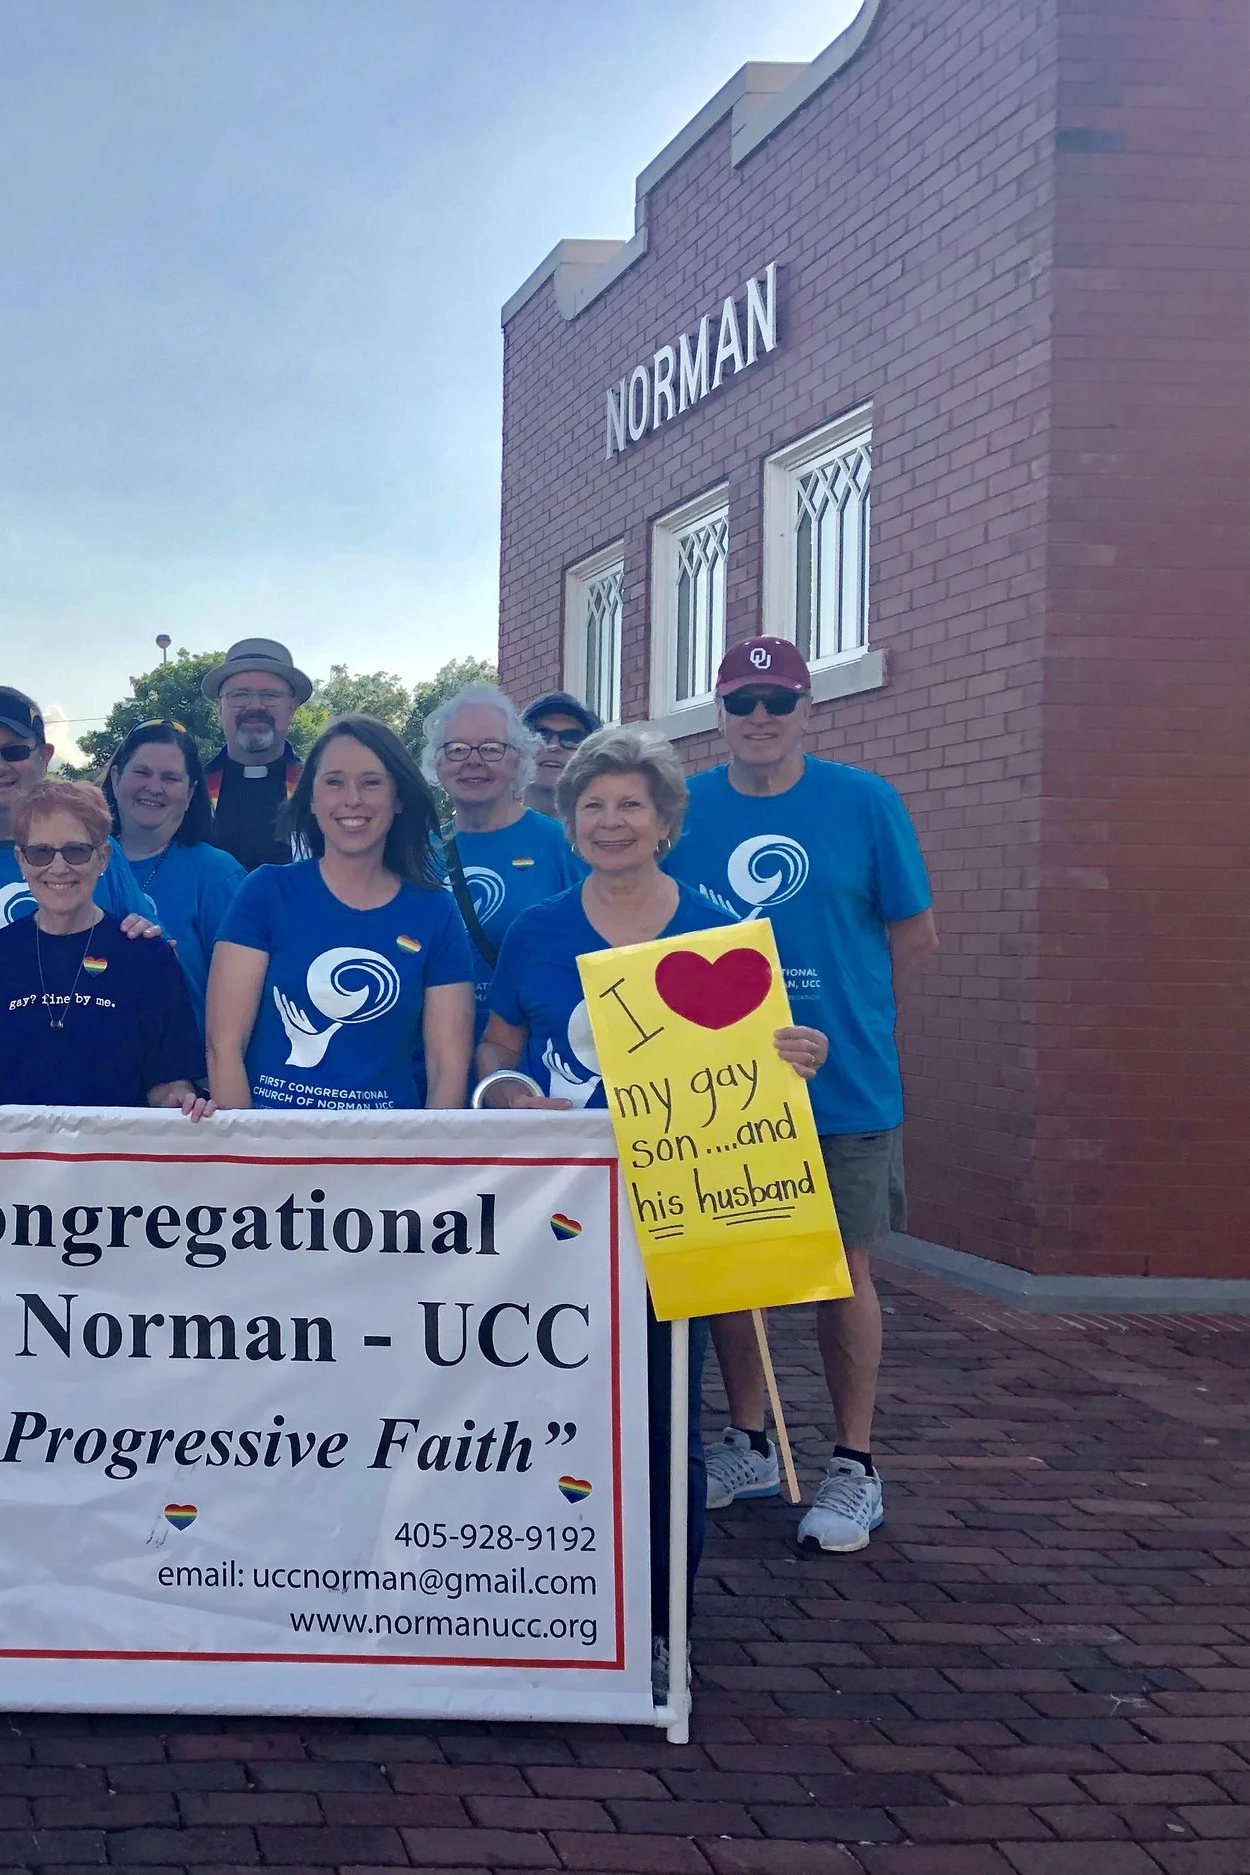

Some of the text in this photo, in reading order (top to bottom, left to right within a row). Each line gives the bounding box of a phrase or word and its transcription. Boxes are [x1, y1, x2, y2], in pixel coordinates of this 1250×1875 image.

[605, 261, 778, 460] NORMAN
[750, 647, 772, 670] OU
[9, 993, 116, 1010] gay? fine by me.
[801, 980, 821, 988] UCC
[599, 977, 664, 1053] I
[253, 1086, 294, 1103] CHURCH
[296, 1096, 314, 1107] OF
[259, 1075, 389, 1100] FIRST CONGREGATIONAL
[614, 1060, 758, 1134] my gay
[632, 1160, 815, 1222] his husband
[15, 1294, 336, 1362] Norman
[364, 1336, 391, 1346] -
[418, 1302, 588, 1369] UCC
[367, 1419, 576, 1472] Faith”
[395, 1522, 596, 1552] 405-928-9192
[158, 1560, 597, 1600] email: uccnorman@gmail.com
[290, 1612, 597, 1646] www.normanucc.org
